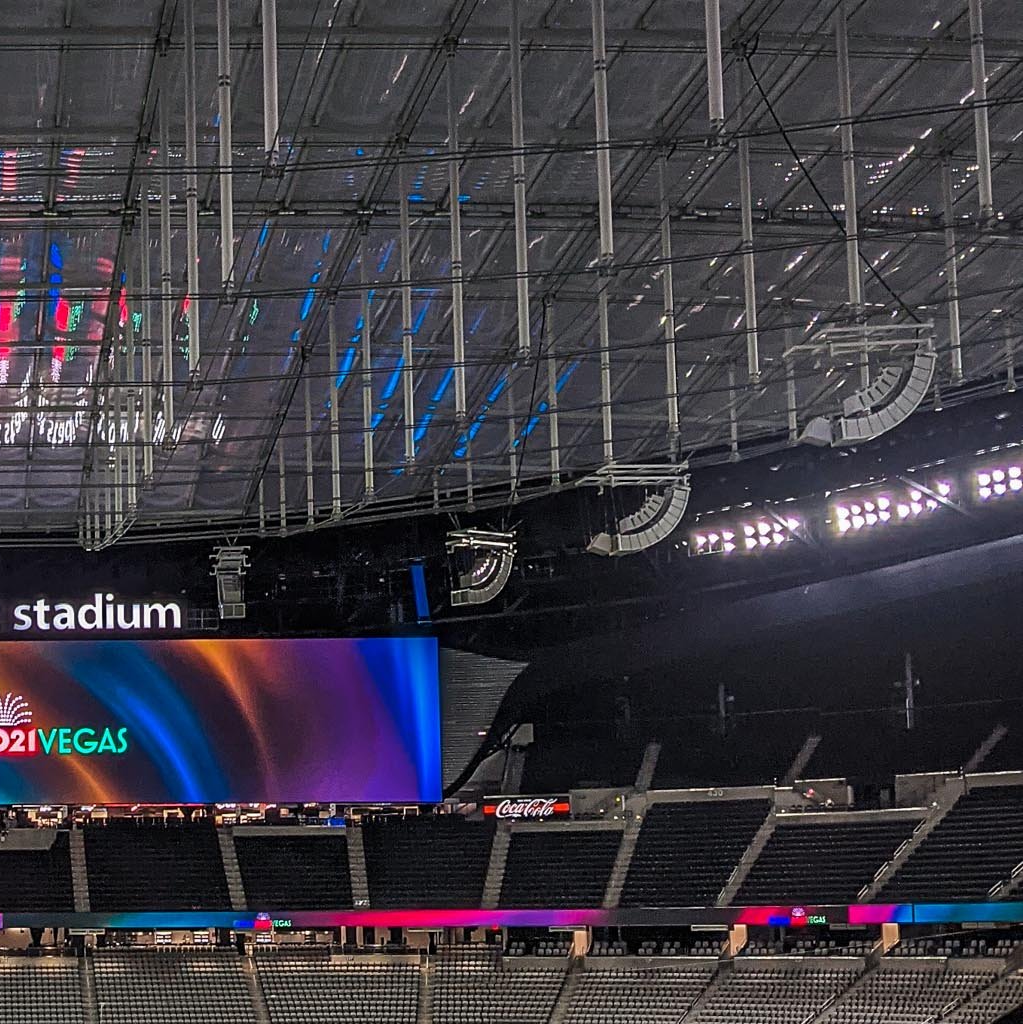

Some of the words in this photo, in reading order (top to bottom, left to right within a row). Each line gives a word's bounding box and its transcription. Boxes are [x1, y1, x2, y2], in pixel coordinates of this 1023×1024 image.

[14, 593, 182, 631] stadium
[37, 727, 128, 754] VEGAS
[496, 798, 558, 818] Coca-Cola
